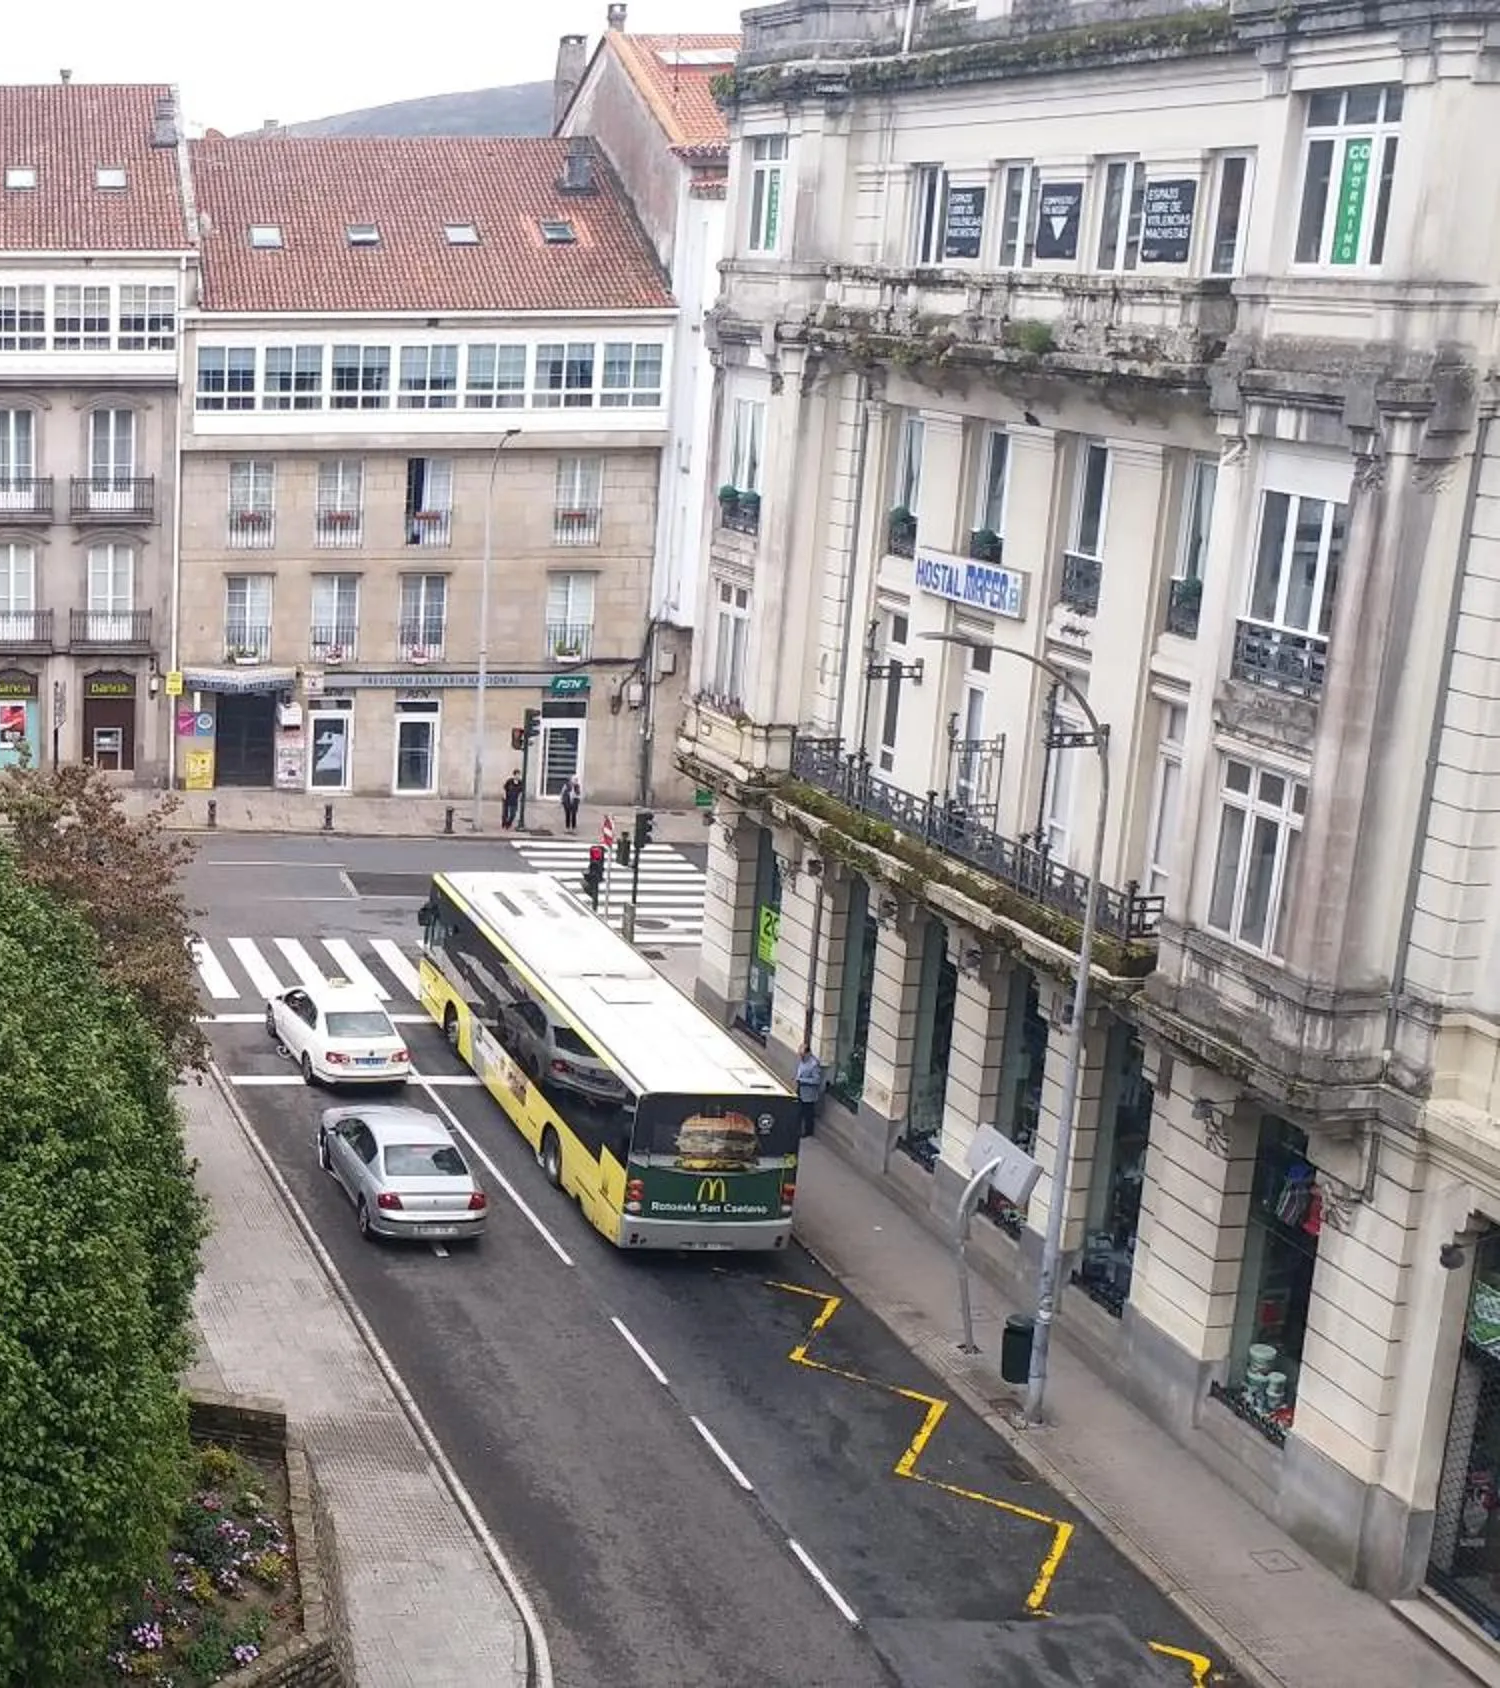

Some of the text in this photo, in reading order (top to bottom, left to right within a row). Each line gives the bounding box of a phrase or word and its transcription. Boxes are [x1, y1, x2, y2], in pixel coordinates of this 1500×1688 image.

[1147, 201, 1182, 213] LIBRE DE
[1147, 213, 1190, 227] VIOLENCIAS
[1145, 227, 1189, 239] MACHISTAS
[916, 558, 960, 596] HOSTAL
[555, 678, 583, 689] PSN
[699, 1203, 721, 1214] San
